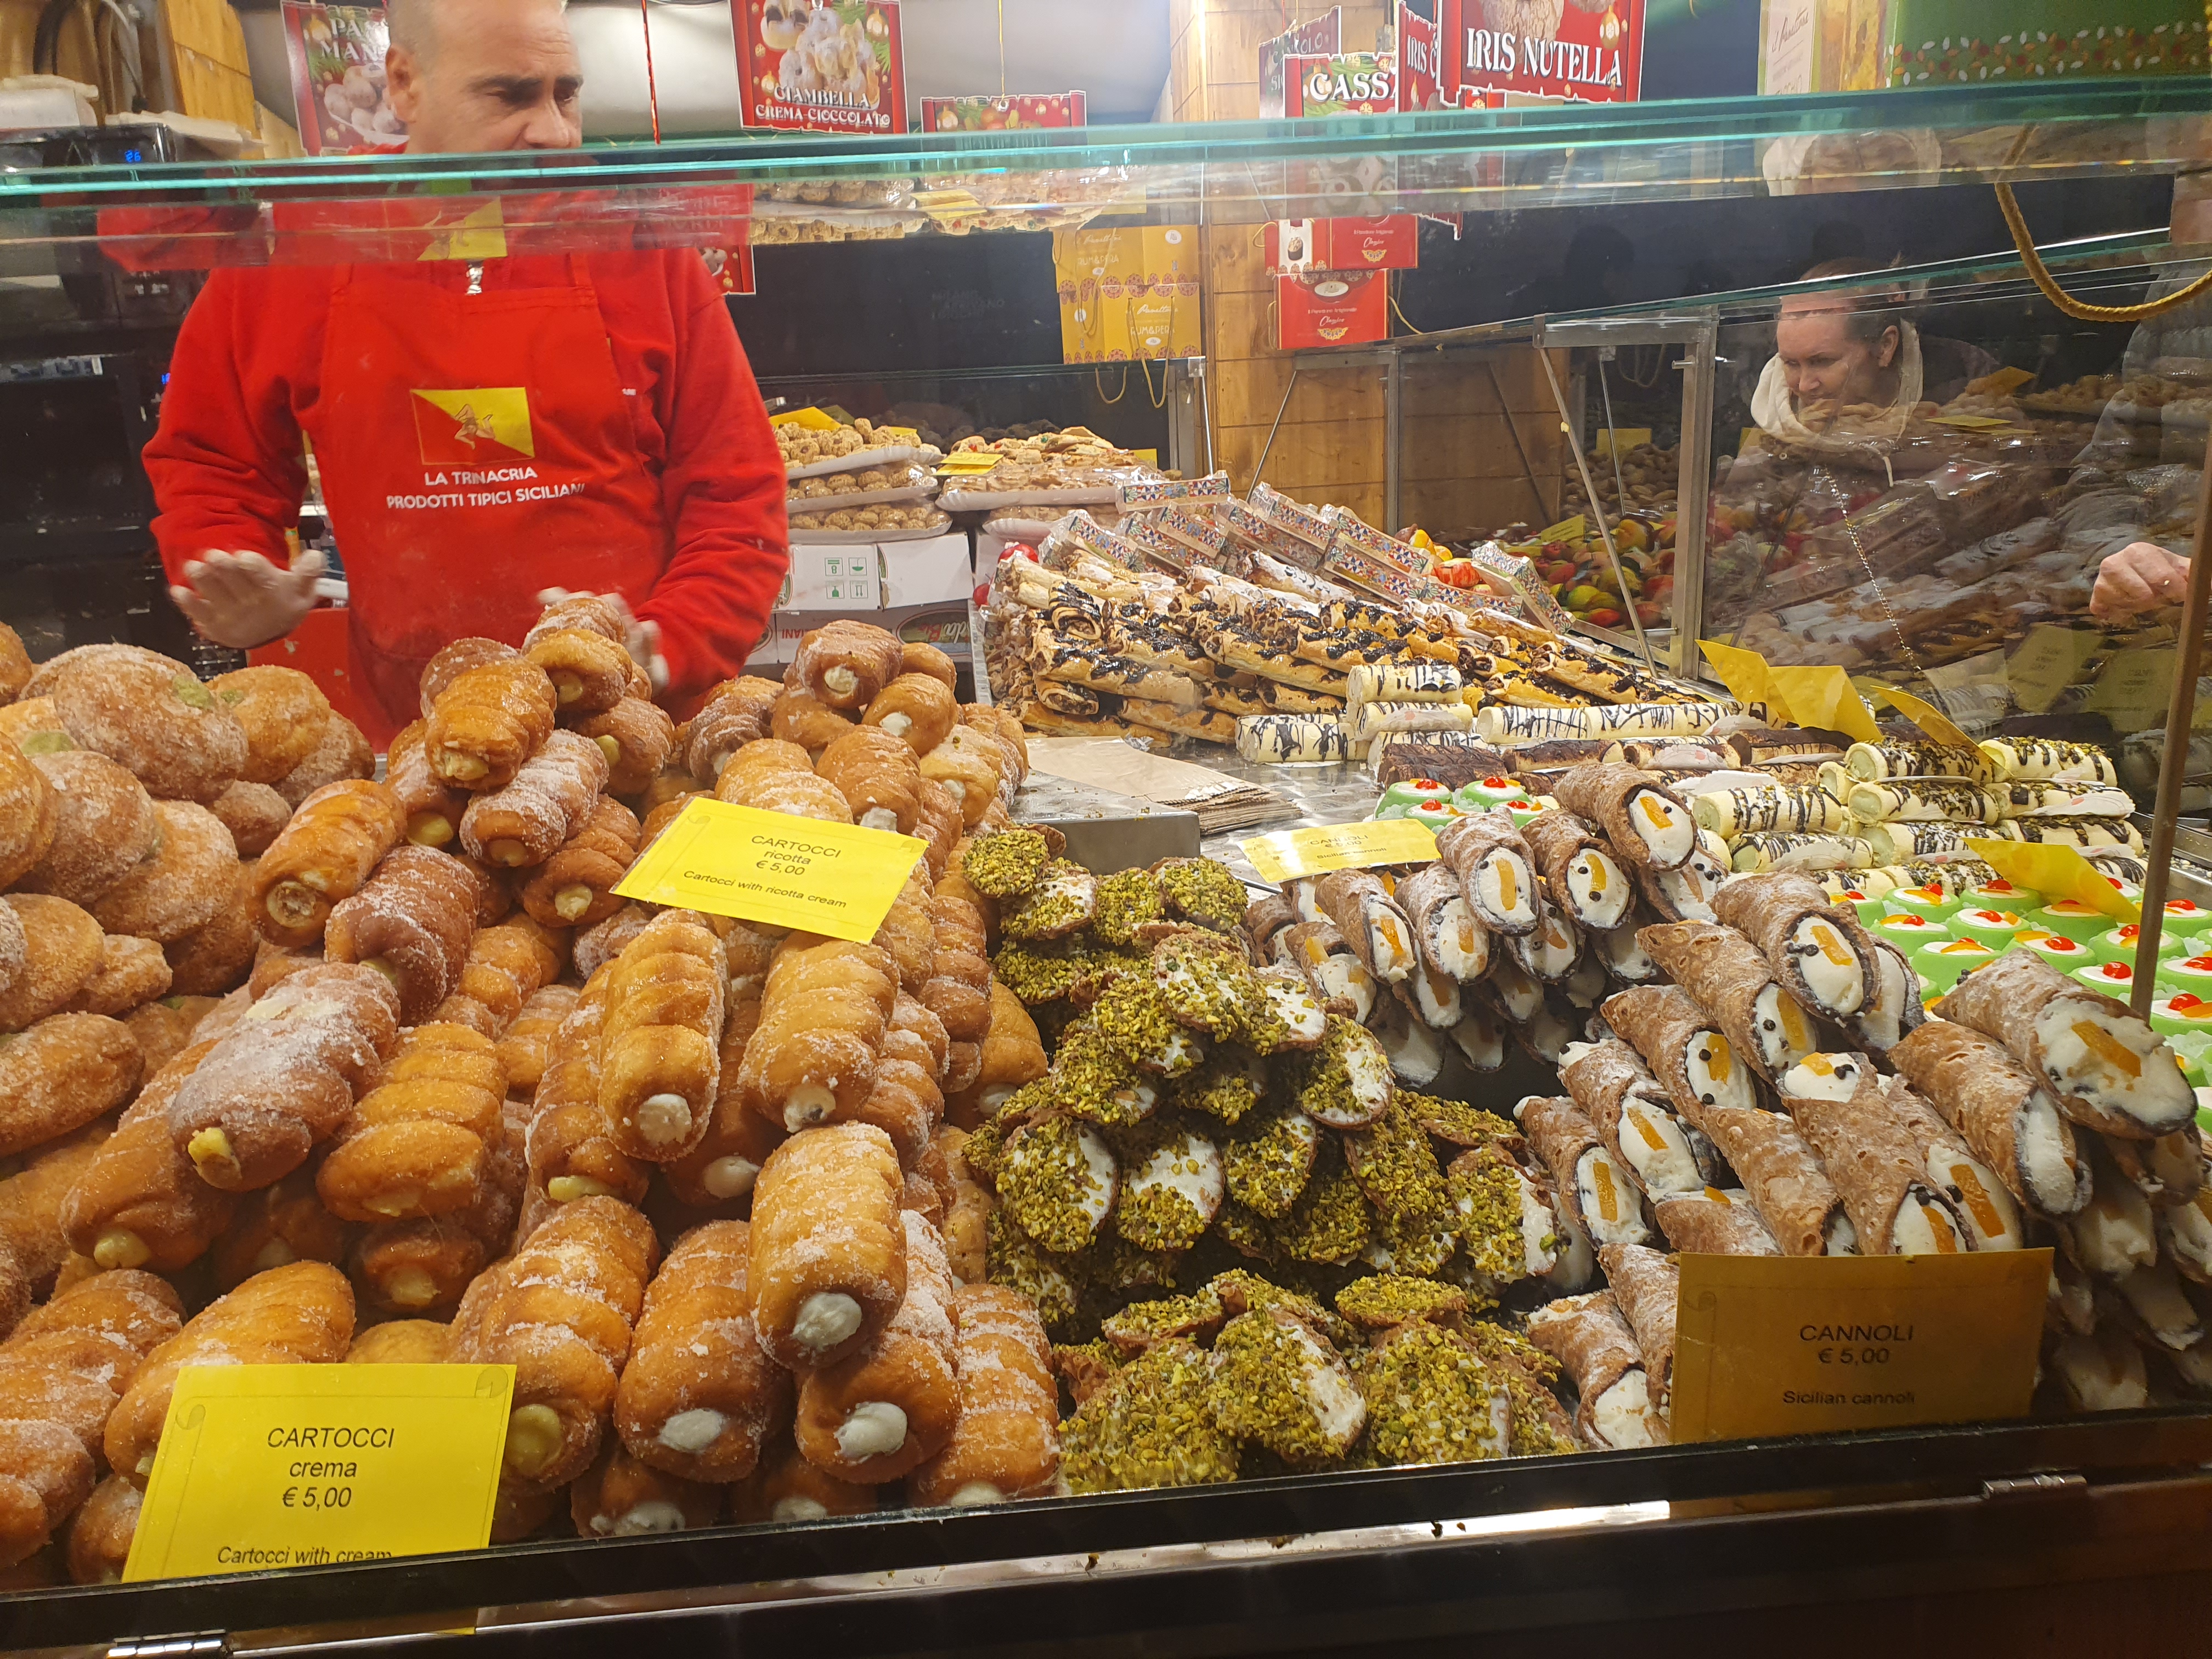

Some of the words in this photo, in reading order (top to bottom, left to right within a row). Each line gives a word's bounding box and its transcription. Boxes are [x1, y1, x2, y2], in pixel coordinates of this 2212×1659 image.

[1407, 35, 1427, 74] IRIS
[1466, 28, 1516, 72] IRIS
[1523, 36, 1622, 87] NUTELLA
[1310, 73, 1396, 103] CASS
[424, 471, 448, 486] LA
[452, 466, 538, 485] TRINACRIA
[386, 494, 464, 510] PRODOTTI
[467, 490, 512, 506] TIPICI
[751, 835, 841, 858] CARTOCCI
[764, 850, 811, 865] ricotta
[756, 860, 769, 869] €
[770, 862, 805, 876] 5,00
[684, 870, 736, 887] Cartocci
[738, 881, 763, 892] with
[766, 886, 804, 899] ricotta
[808, 895, 847, 908] cream
[1800, 1325, 1914, 1341] CANNOLI
[1819, 1348, 1833, 1364] €
[1840, 1347, 1889, 1366] 5,00
[1783, 1390, 1846, 1404] Sicilian
[267, 1427, 395, 1449] CARTOCCI
[290, 1462, 357, 1478] crema
[283, 1487, 297, 1508] €
[302, 1487, 352, 1512] 5,00
[218, 1546, 290, 1564] Cartocci
[295, 1547, 329, 1565] with
